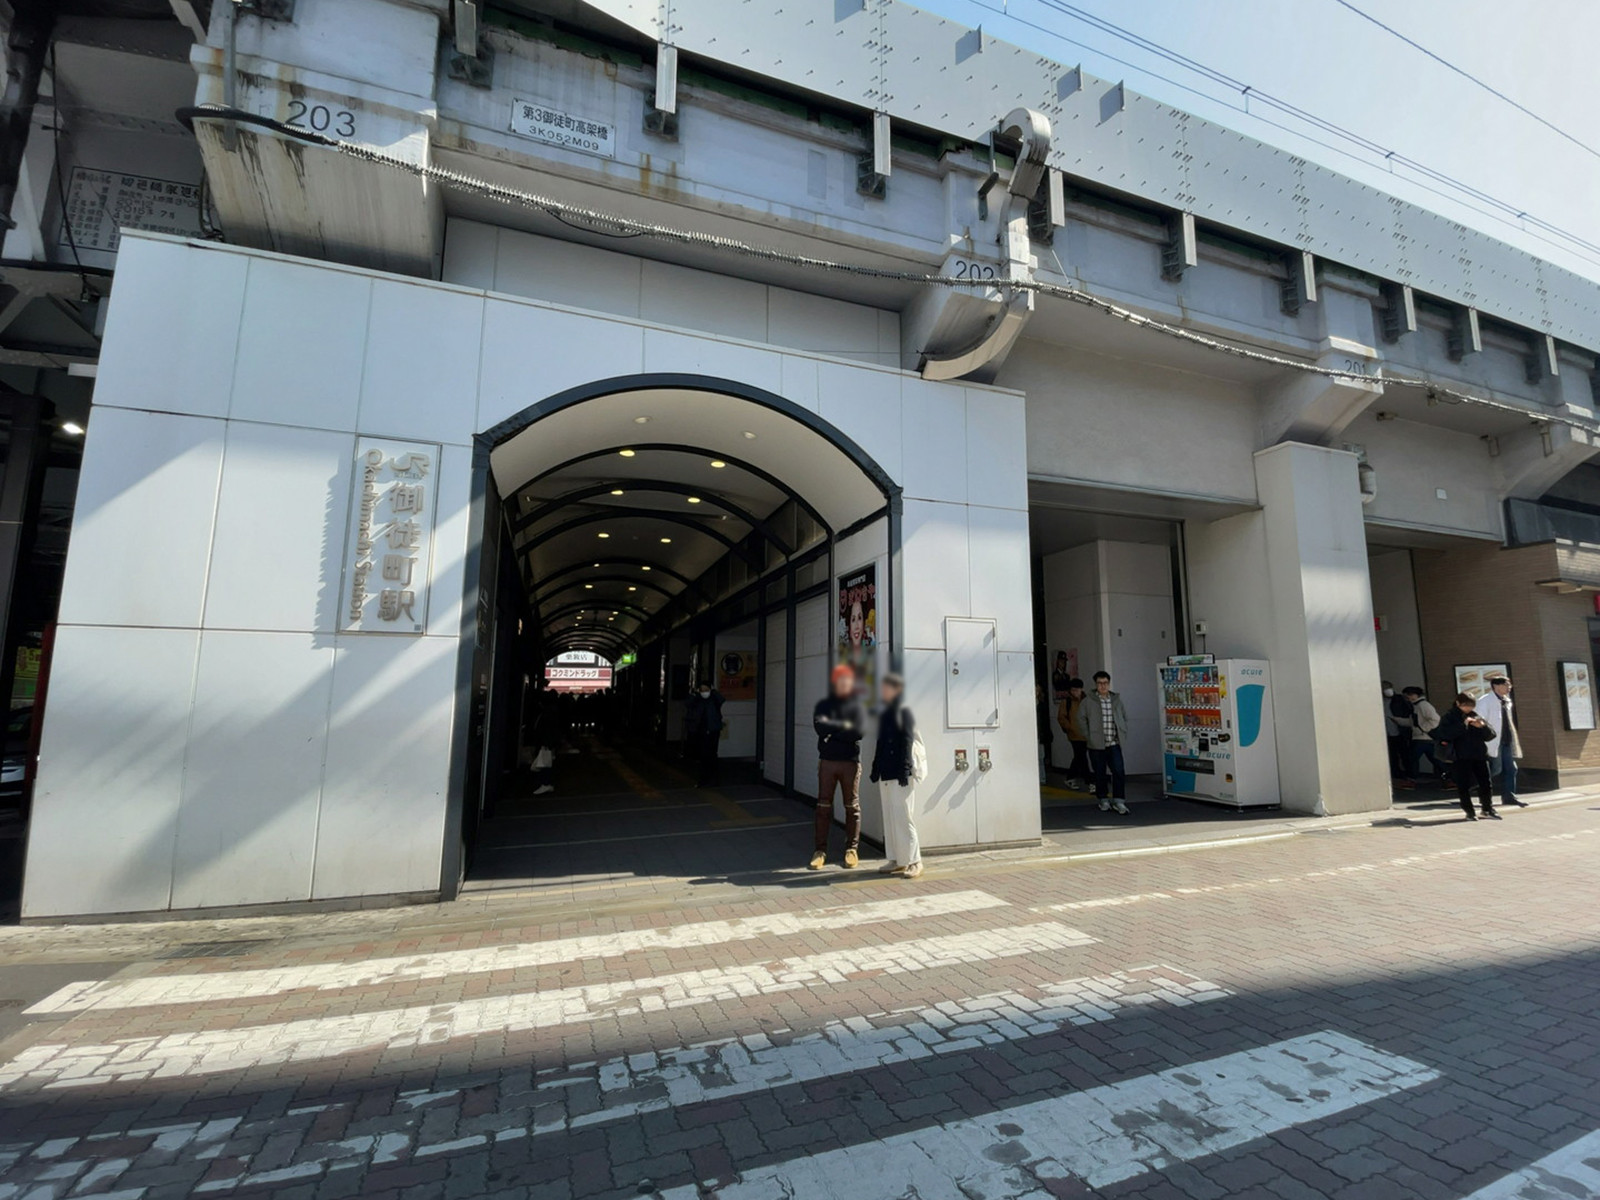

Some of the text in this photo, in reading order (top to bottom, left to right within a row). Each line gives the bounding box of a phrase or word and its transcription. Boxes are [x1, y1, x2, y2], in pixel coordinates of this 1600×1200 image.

[285, 100, 355, 137] 203
[522, 105, 608, 140] 第3御徒町高架橋
[528, 125, 599, 151] 3K052M09
[349, 448, 383, 621] Okachimachi Station
[552, 669, 597, 677] コクミンドラッグ
[1240, 668, 1264, 676] acure
[1206, 751, 1231, 760] acure
